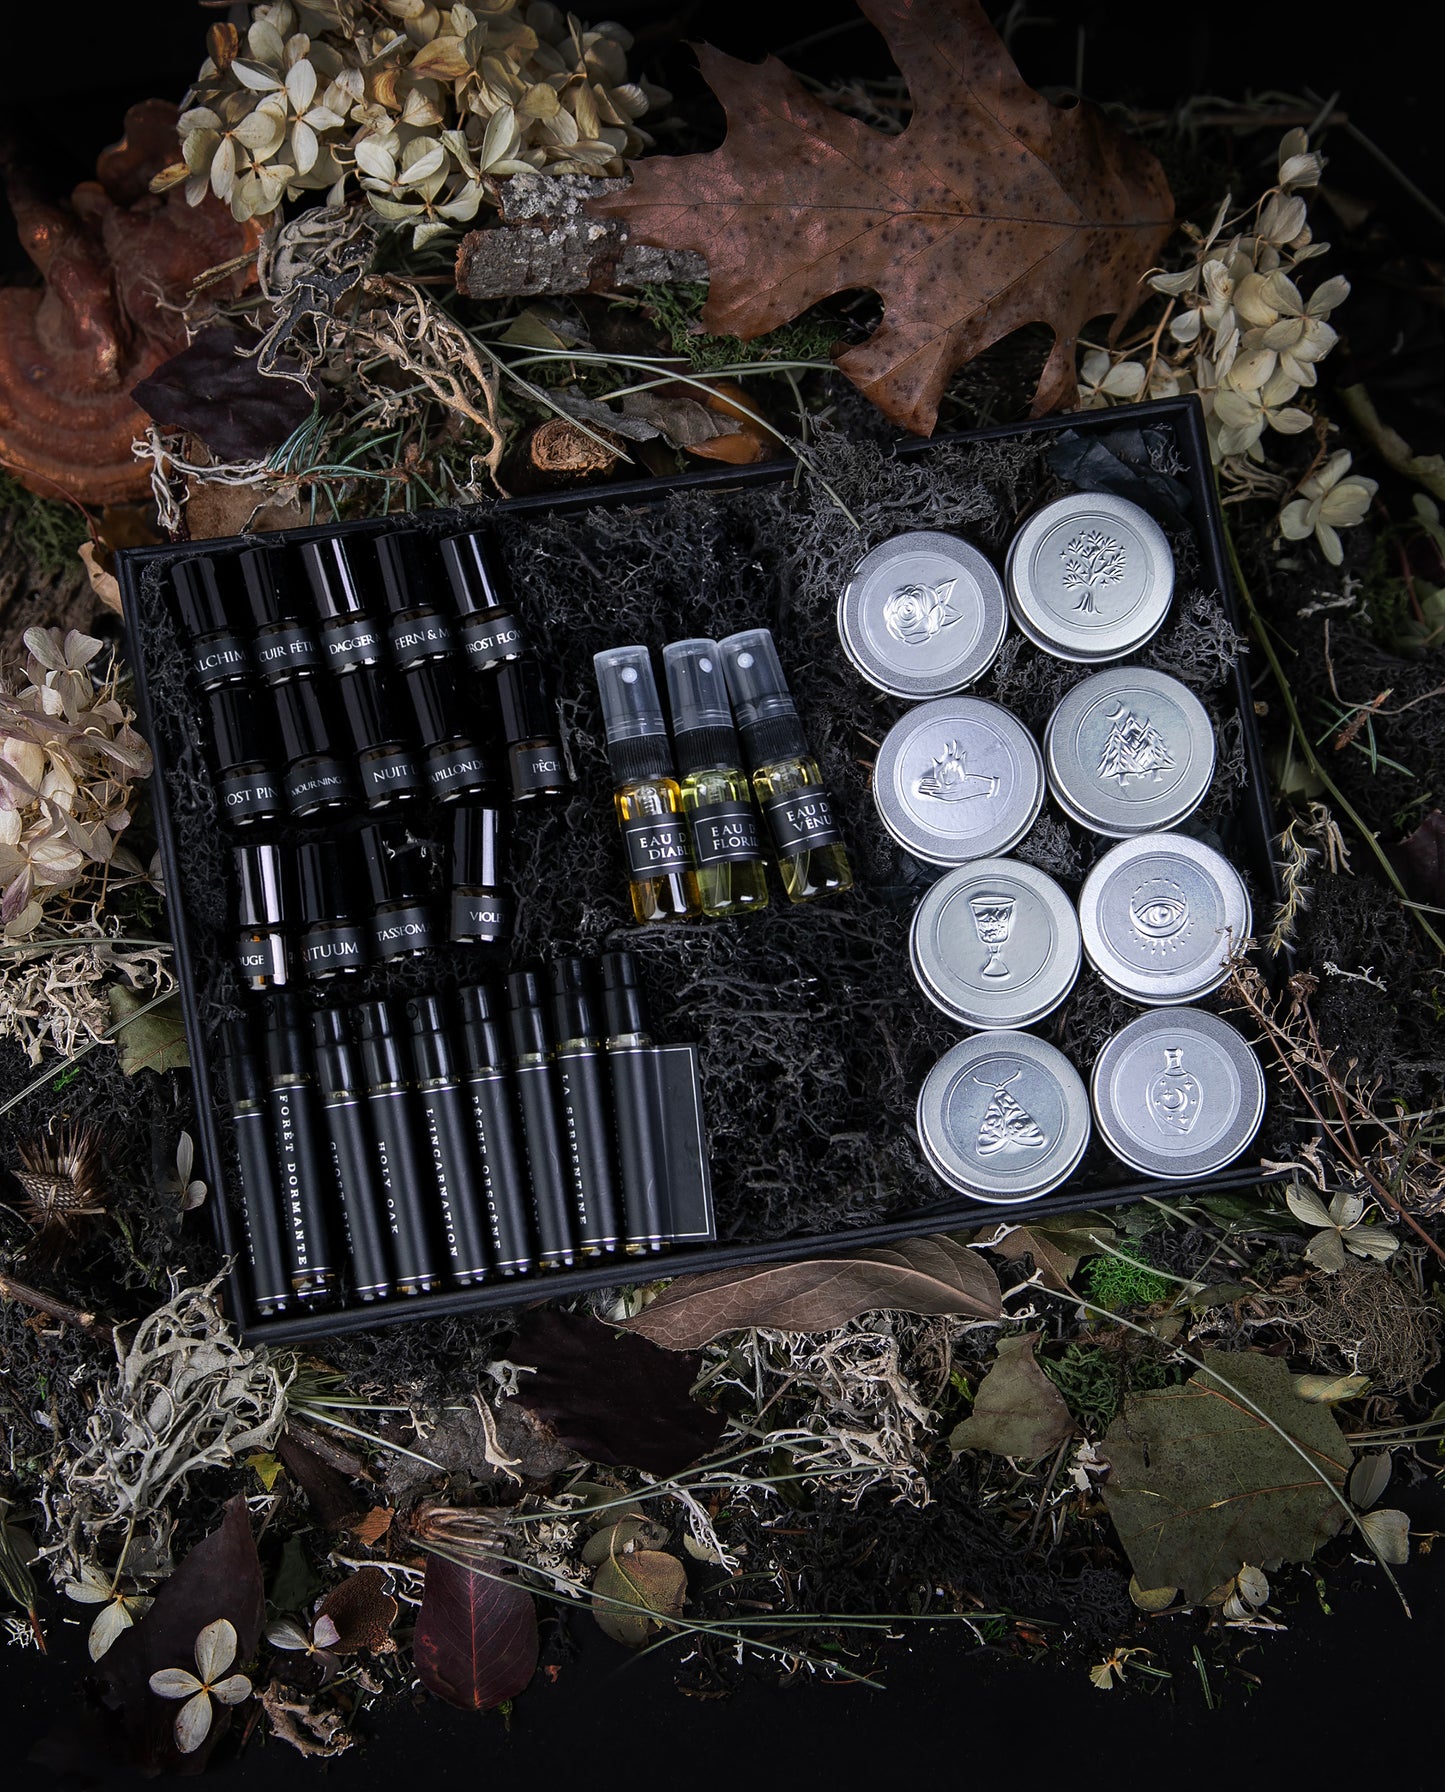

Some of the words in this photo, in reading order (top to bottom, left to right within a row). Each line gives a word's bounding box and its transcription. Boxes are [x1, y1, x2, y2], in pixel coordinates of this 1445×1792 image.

[329, 634, 375, 655] DAGGER
[395, 631, 425, 650] FERN
[427, 629, 437, 640] &
[258, 646, 287, 663] CUIR
[373, 765, 409, 783] NUIT
[225, 789, 252, 807] OST
[786, 804, 816, 822] EAU
[711, 823, 743, 837] EAU
[792, 815, 832, 832] VÉNU
[639, 833, 672, 848] EAU
[240, 955, 265, 967] UGE
[566, 1106, 587, 1225] SERPENTINE
[279, 1095, 295, 1152] FORÊT
[287, 1163, 307, 1265] DORMANTE
[378, 1141, 392, 1188] HOLY
[387, 1198, 399, 1234] OAK
[426, 1108, 458, 1257] L'INCARNATION
